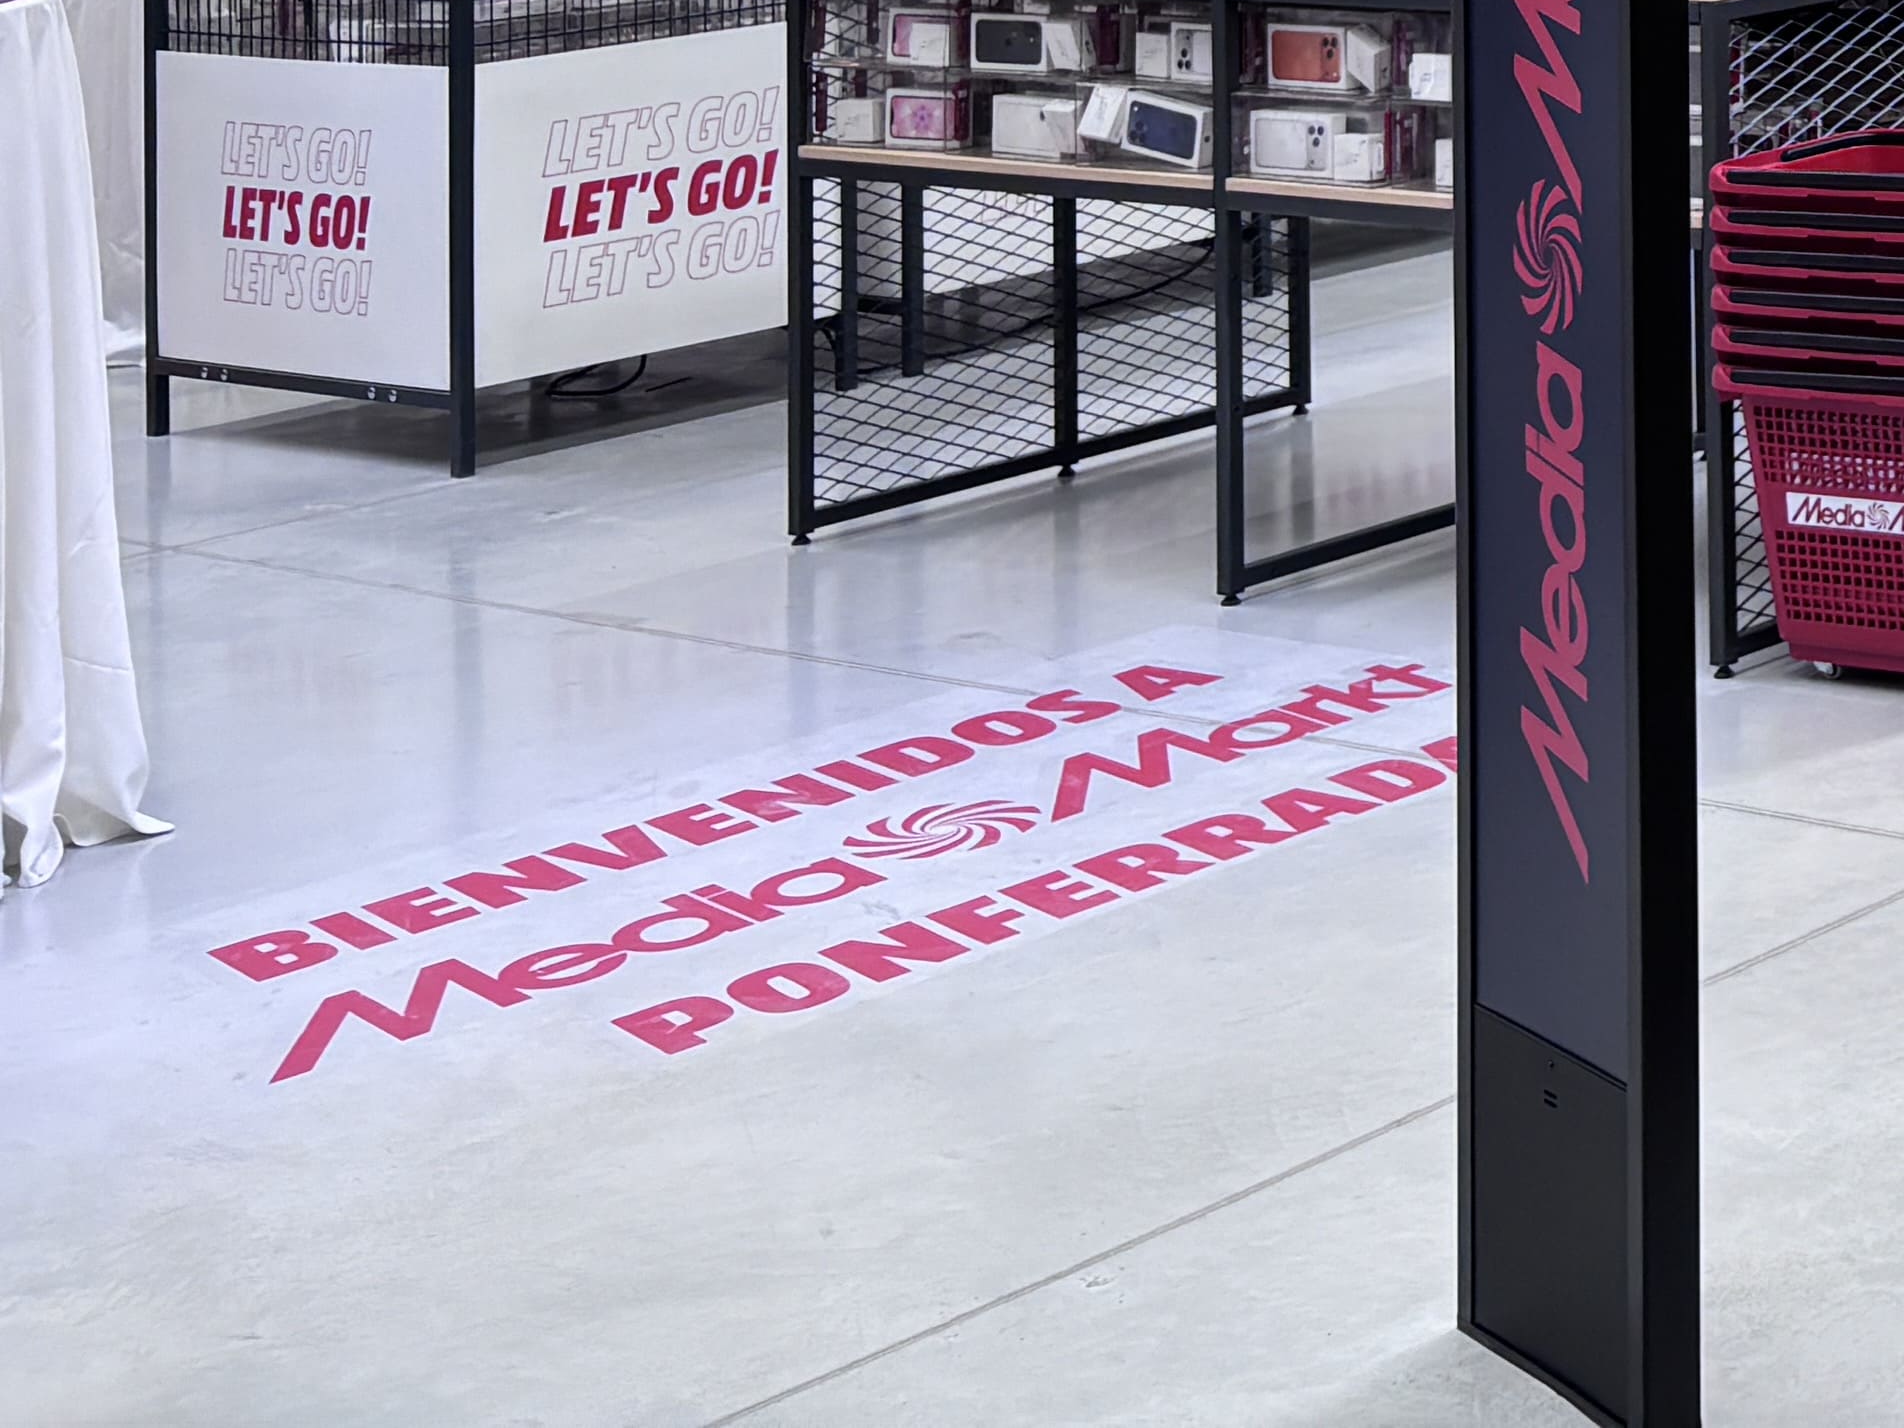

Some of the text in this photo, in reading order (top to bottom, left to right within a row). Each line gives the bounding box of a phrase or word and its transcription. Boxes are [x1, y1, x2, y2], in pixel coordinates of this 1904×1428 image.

[221, 121, 372, 186] LET'S GO!
[541, 85, 780, 178] LET'S GO!
[222, 185, 371, 251] LET'S GO!
[543, 149, 779, 243] LET'S GO!
[223, 248, 372, 316] LET'S GO!
[543, 209, 781, 308] LET'S GO!
[1792, 495, 1866, 528] Media
[1519, 342, 1589, 883] Media
[209, 664, 1221, 982] BIENVENIDOS A
[270, 663, 1455, 1084] Media Markt
